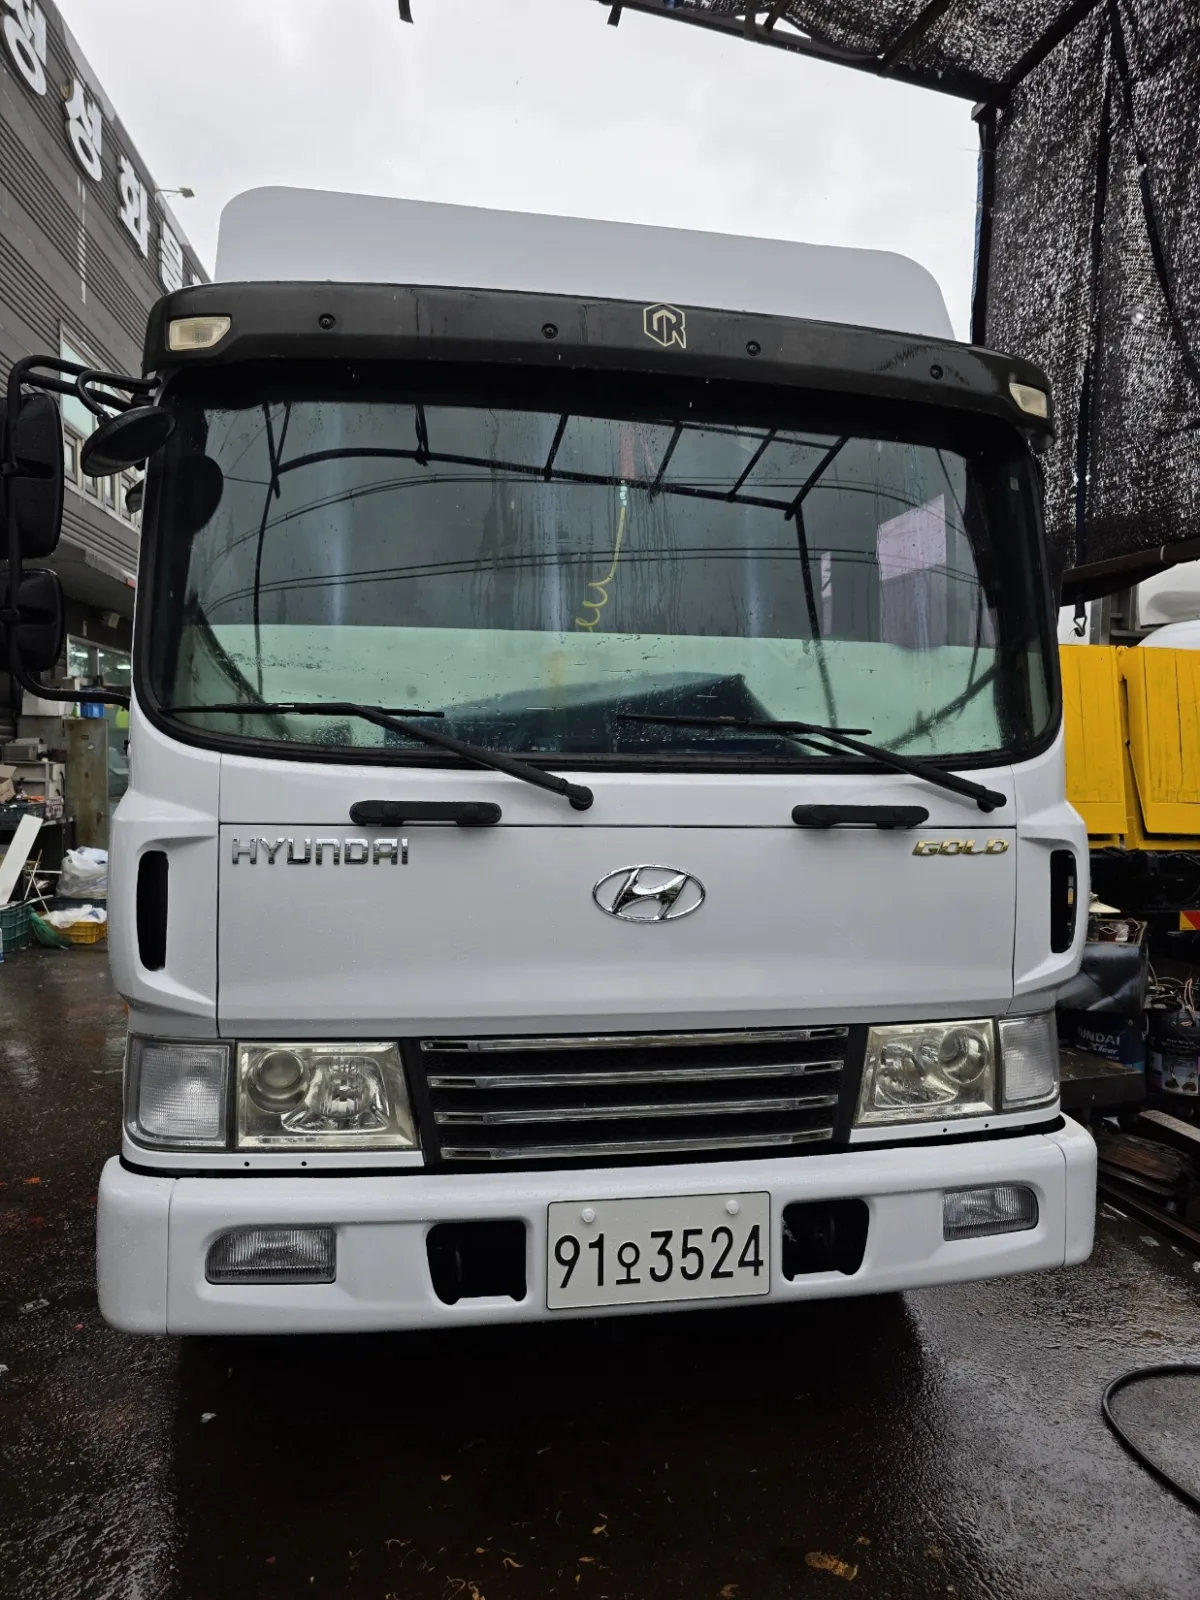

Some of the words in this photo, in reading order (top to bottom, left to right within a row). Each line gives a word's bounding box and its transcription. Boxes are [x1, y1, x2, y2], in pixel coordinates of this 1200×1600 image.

[232, 838, 408, 865] HYUNDAI
[911, 839, 1009, 856] GOLD
[1079, 1027, 1120, 1046] UNDAI
[554, 1225, 764, 1288] 91오3524
